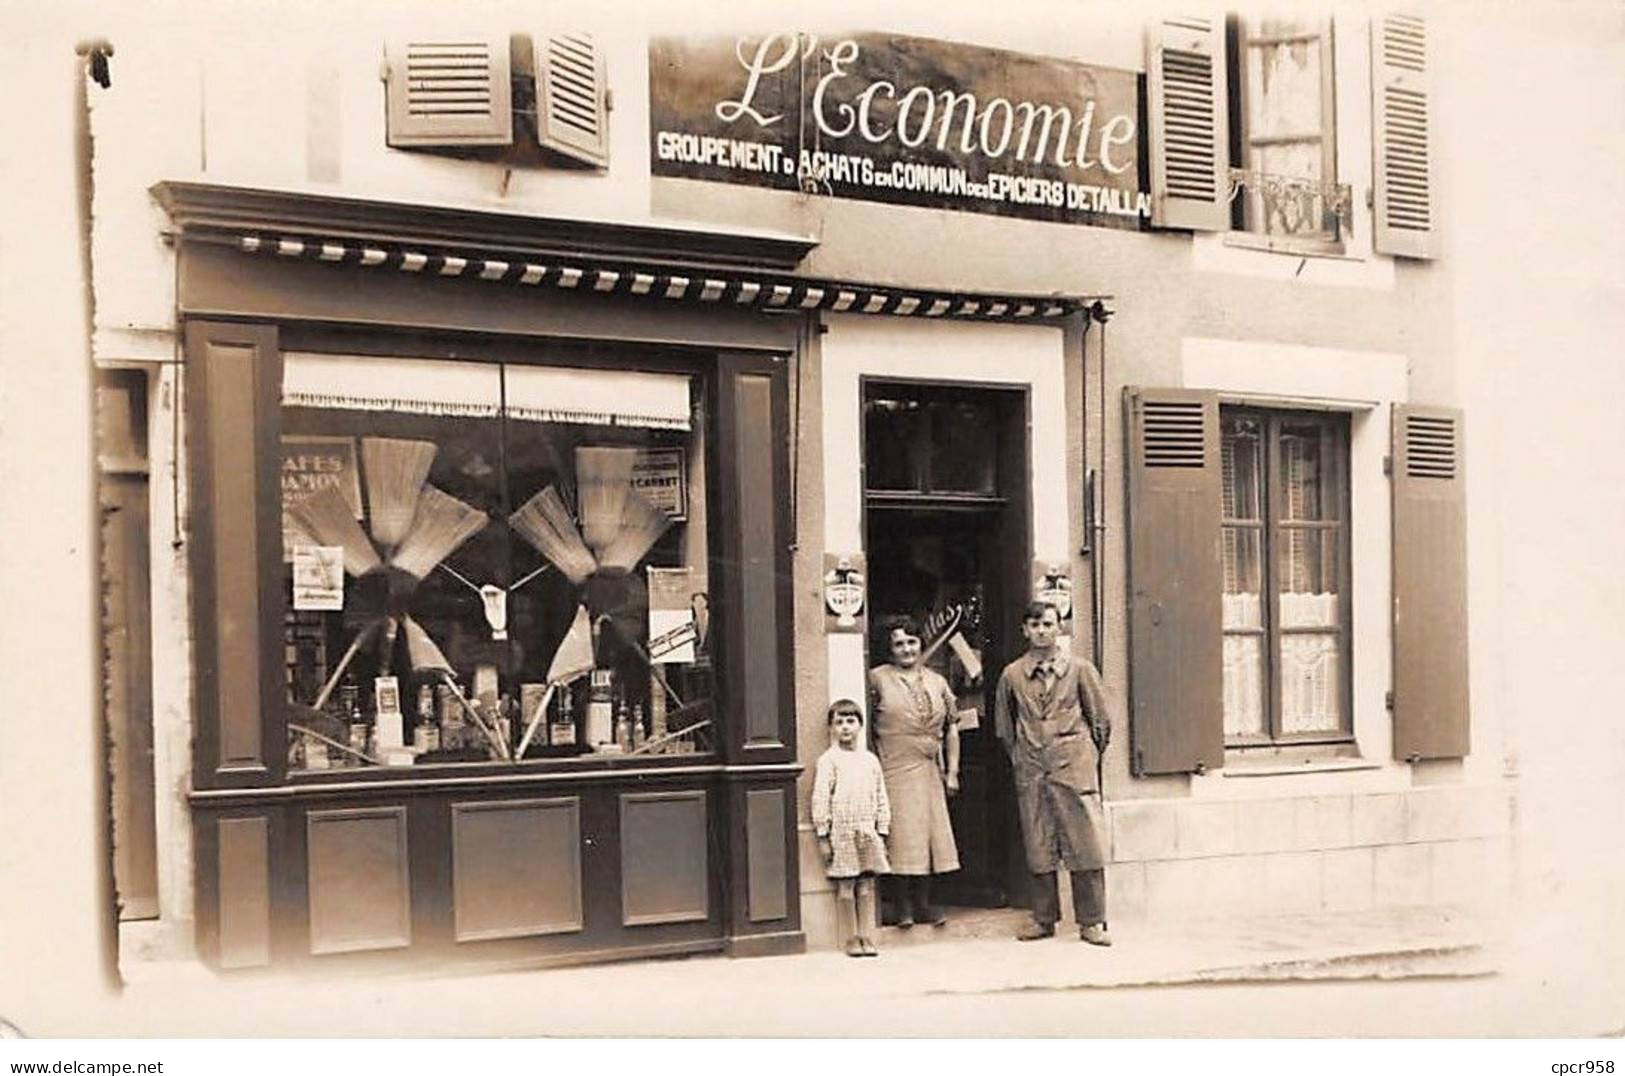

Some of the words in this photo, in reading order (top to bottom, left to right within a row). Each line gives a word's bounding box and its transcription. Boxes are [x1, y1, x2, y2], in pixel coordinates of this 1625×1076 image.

[657, 131, 782, 173] GROUPEMENT
[875, 171, 893, 188] EN
[892, 161, 967, 196] COMMUN
[987, 172, 1064, 207] EPICIERS
